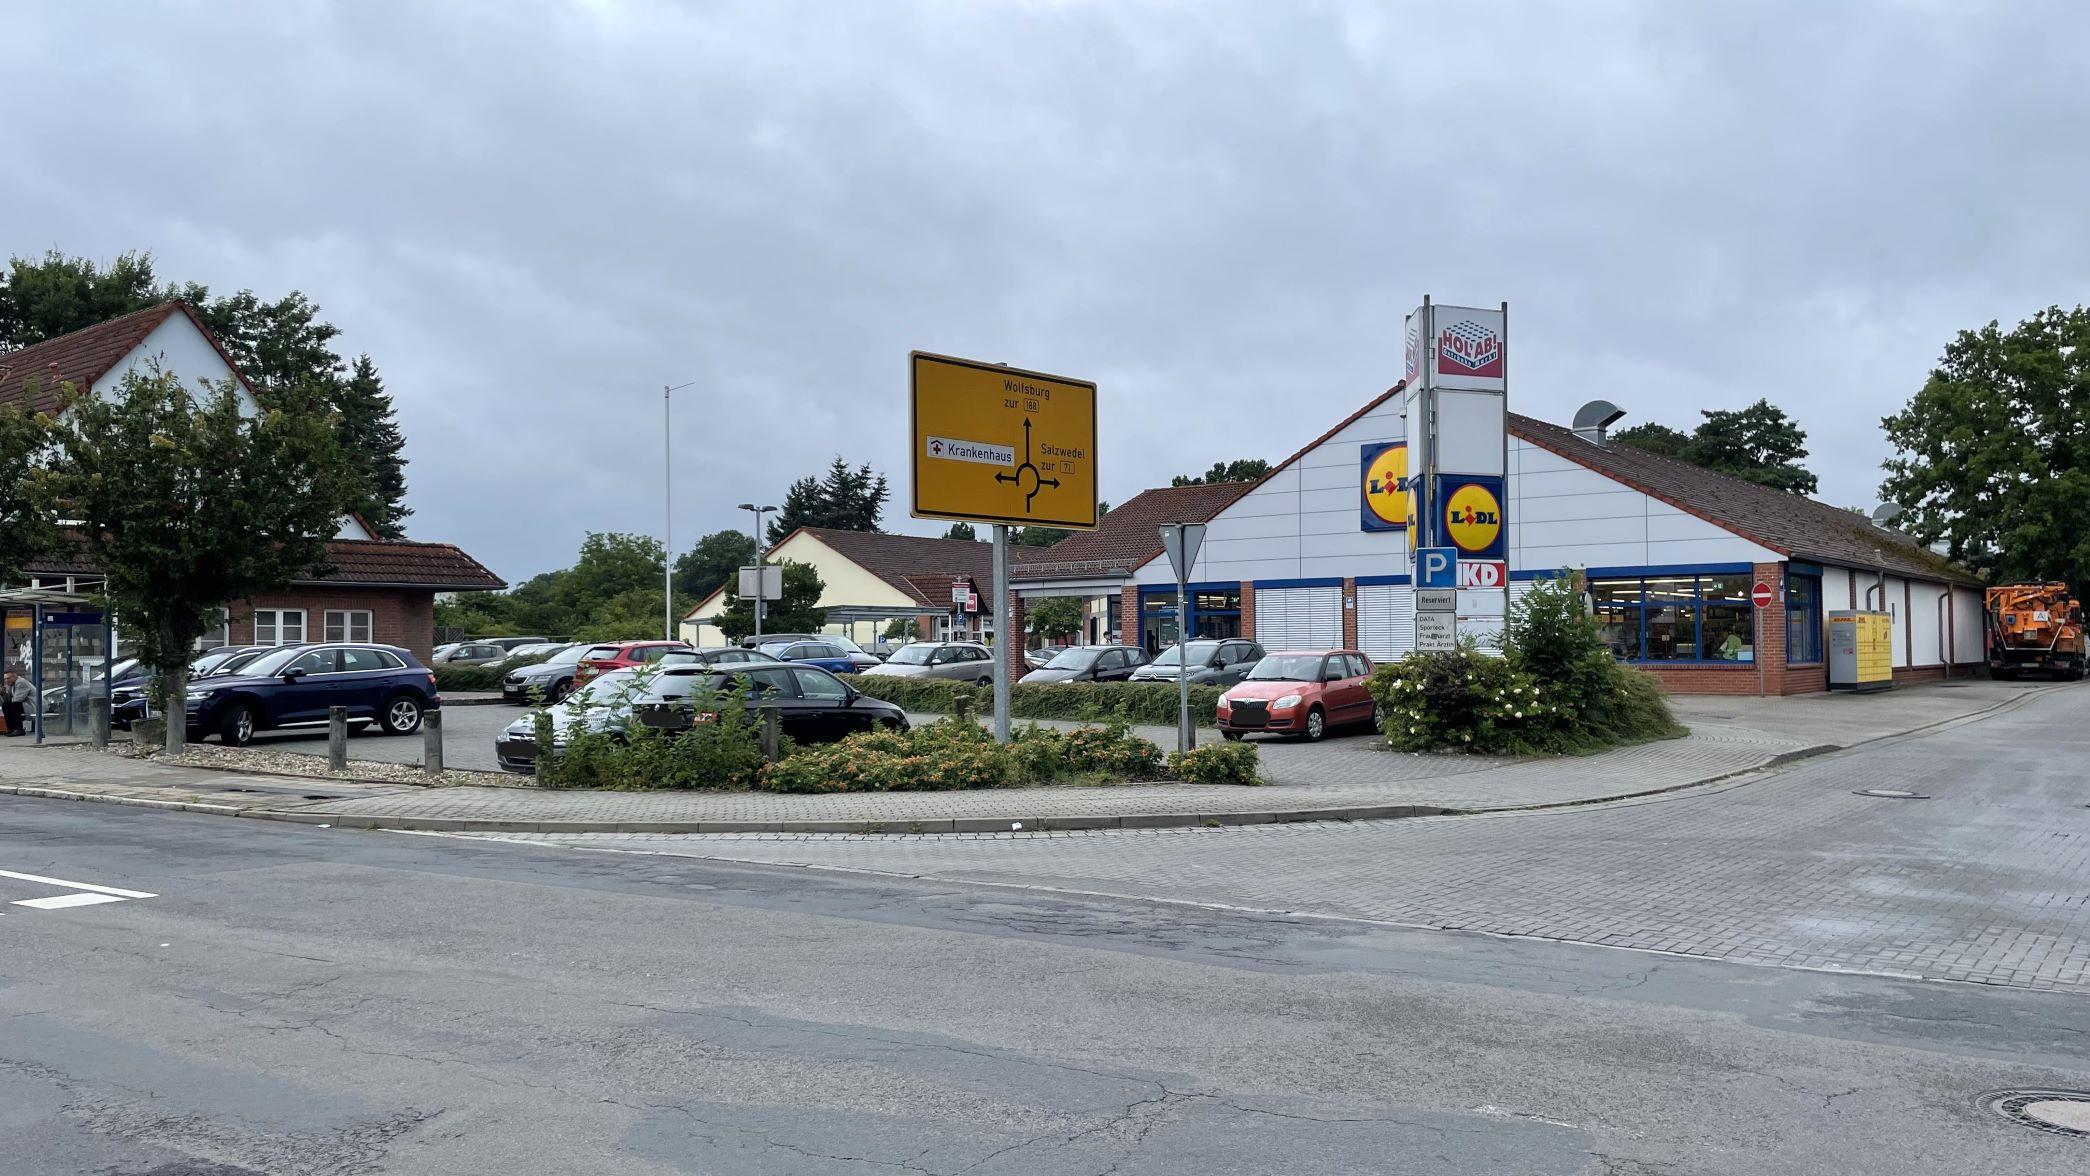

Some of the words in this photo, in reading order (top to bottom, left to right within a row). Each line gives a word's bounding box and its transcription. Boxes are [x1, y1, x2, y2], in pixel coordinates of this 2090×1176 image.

[1004, 380, 1050, 400] Wolfsburg
[1004, 399, 1019, 409] zur
[1026, 401, 1037, 410] 188
[948, 443, 1012, 462] Krankenhaus
[1041, 443, 1085, 459] Salzwedel
[1041, 461, 1055, 471] zur
[1063, 463, 1071, 472] 71
[1426, 553, 1447, 583] P
[1421, 596, 1451, 604] Reserviert
